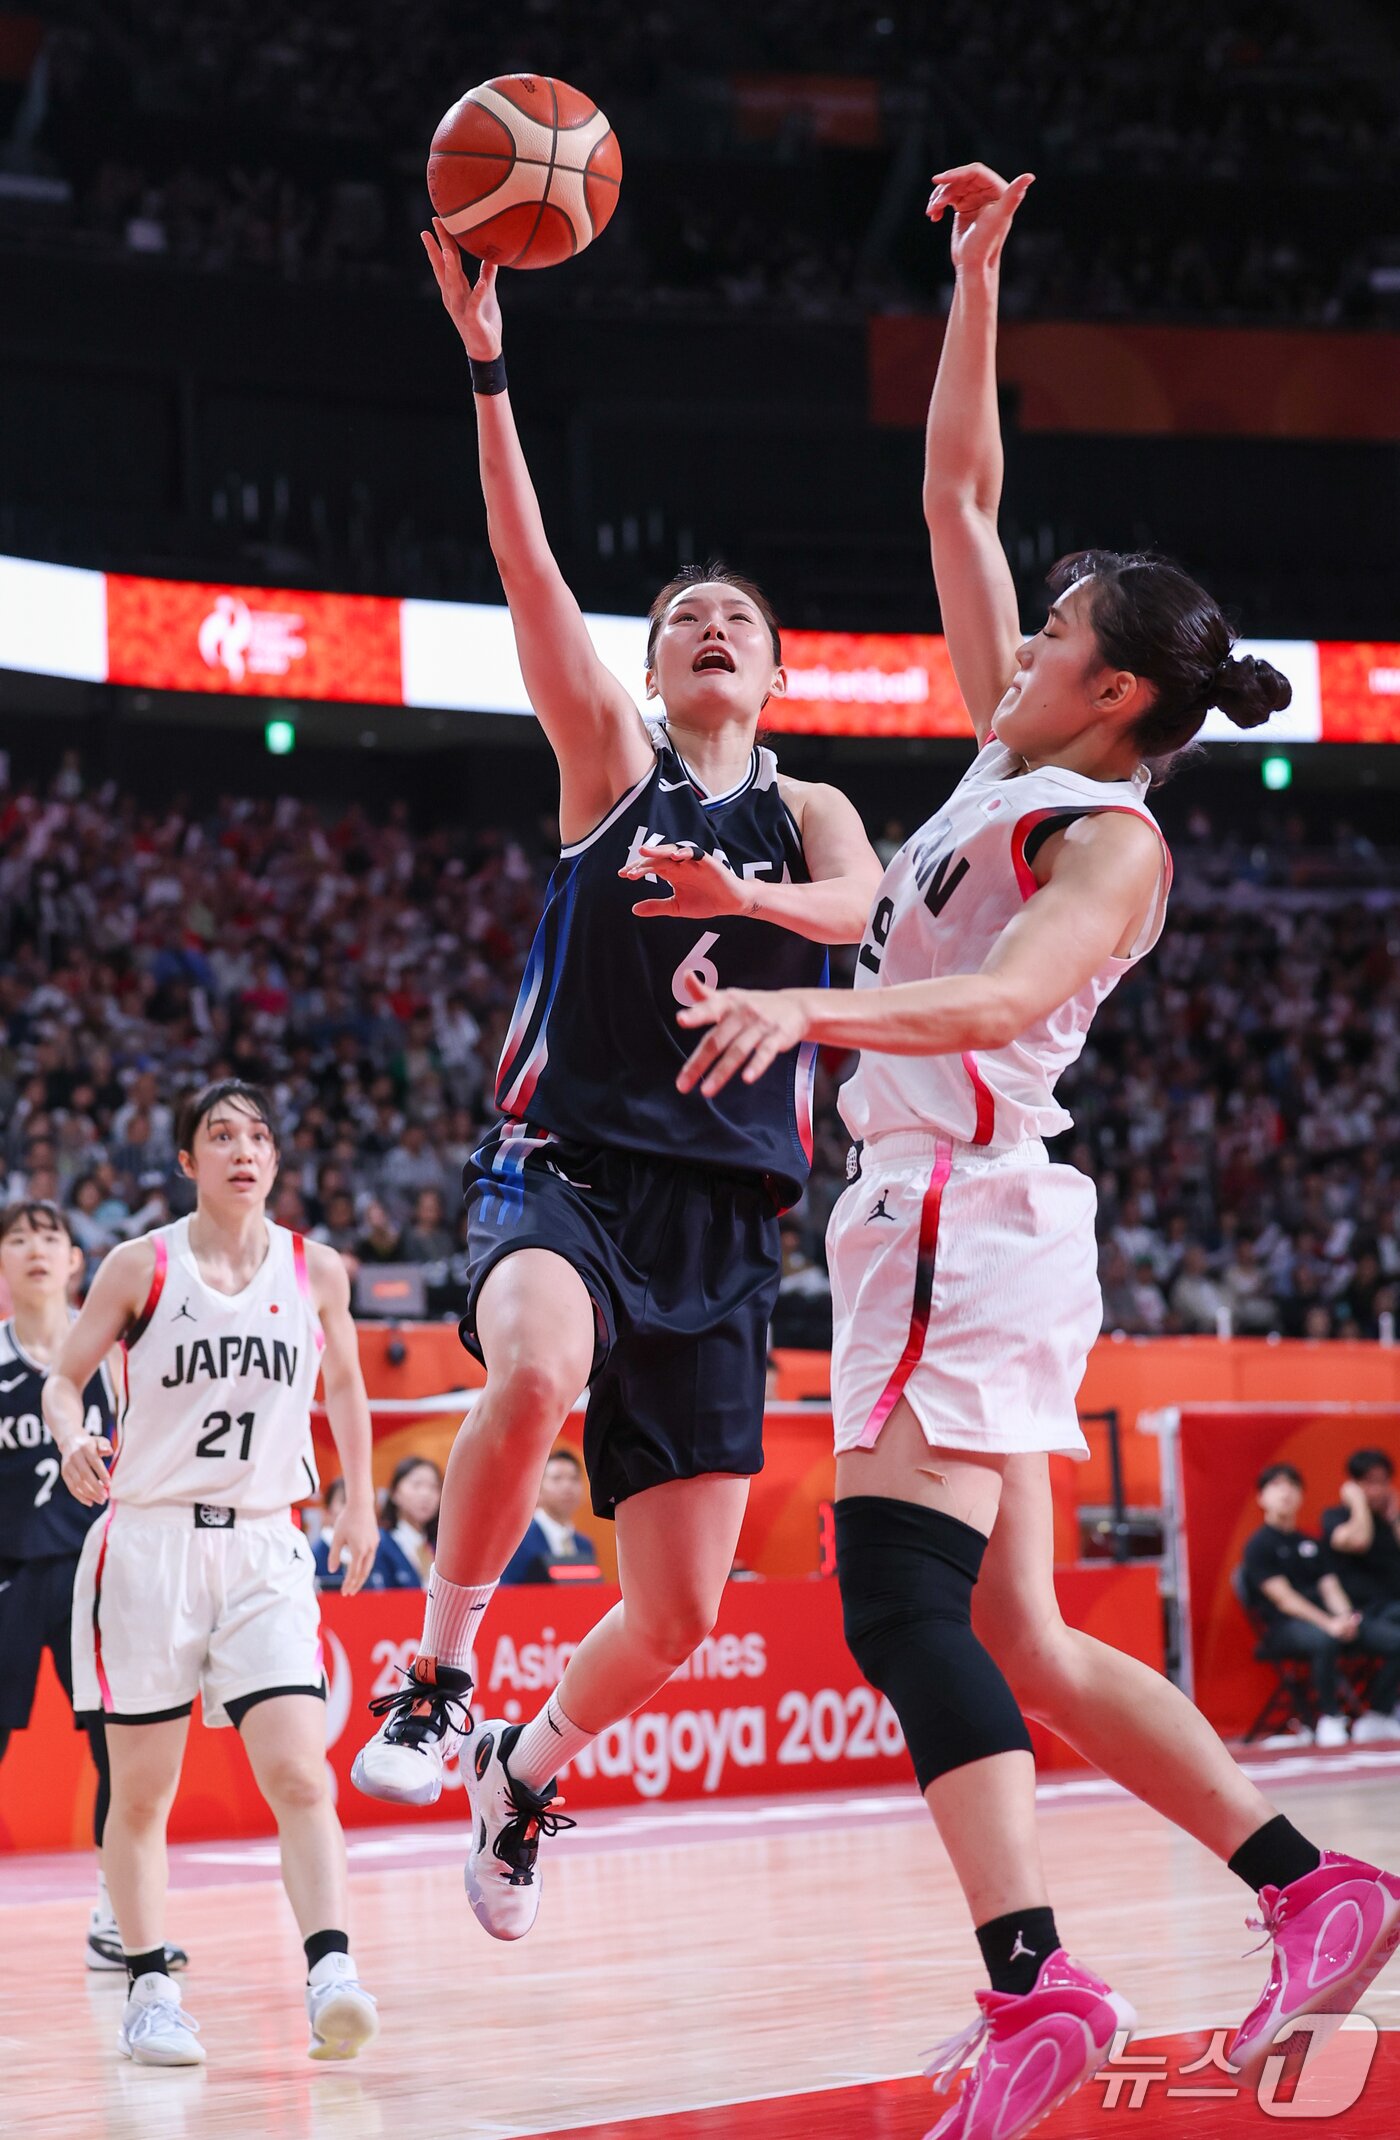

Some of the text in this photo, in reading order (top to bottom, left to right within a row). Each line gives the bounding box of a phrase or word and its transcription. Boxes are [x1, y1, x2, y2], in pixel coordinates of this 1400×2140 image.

[671, 930, 721, 1008] 6
[162, 1336, 298, 1389] JAPAN
[0, 1404, 103, 1451] KOA
[196, 1410, 256, 1461] 21
[776, 1688, 906, 1765] 2026
